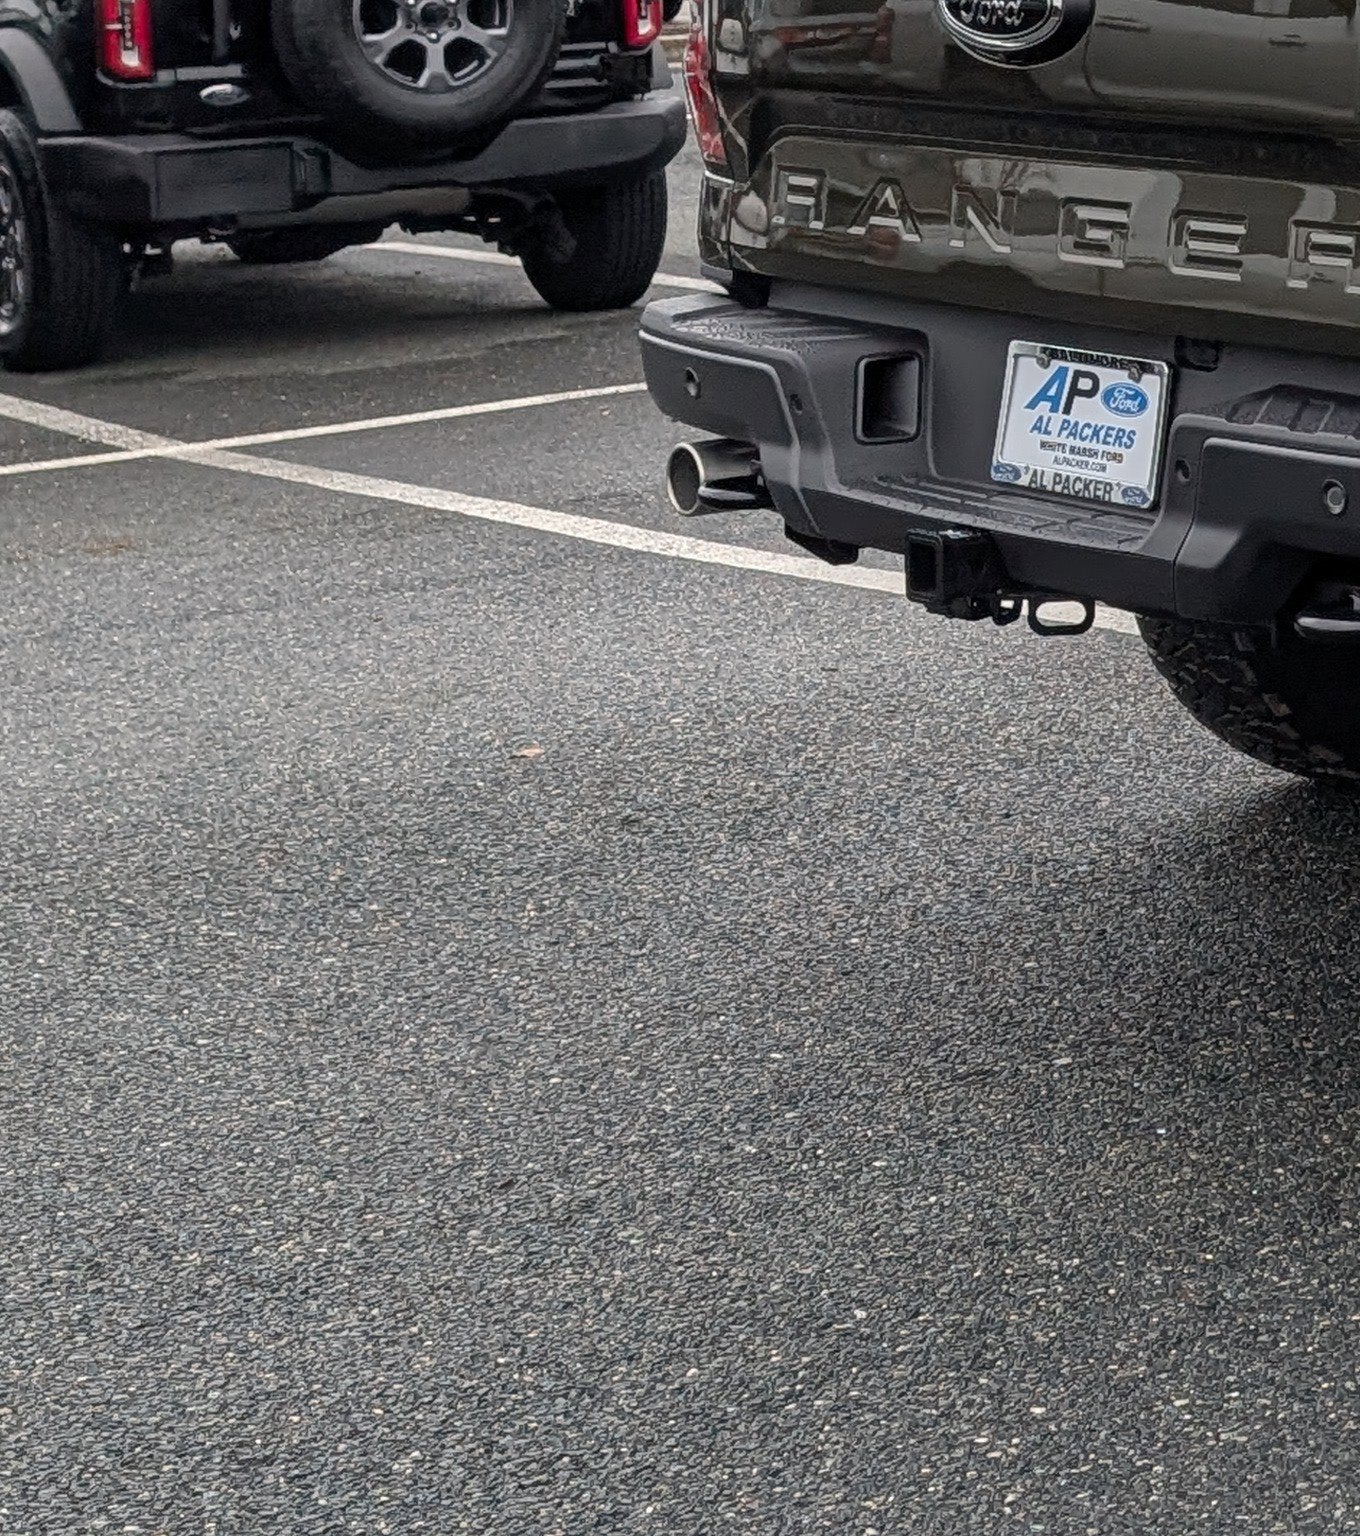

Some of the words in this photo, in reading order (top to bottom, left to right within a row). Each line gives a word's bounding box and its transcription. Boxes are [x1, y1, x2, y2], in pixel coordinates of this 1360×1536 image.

[1024, 365, 1100, 417] AP
[1108, 387, 1141, 413] Ford
[1029, 414, 1053, 436] AL
[1057, 418, 1137, 450] PACKERS
[1053, 455, 1108, 474] ALPACKER.COM
[1100, 450, 1124, 465] FORD
[1028, 469, 1048, 491] AL
[1051, 471, 1114, 503] PACKER
